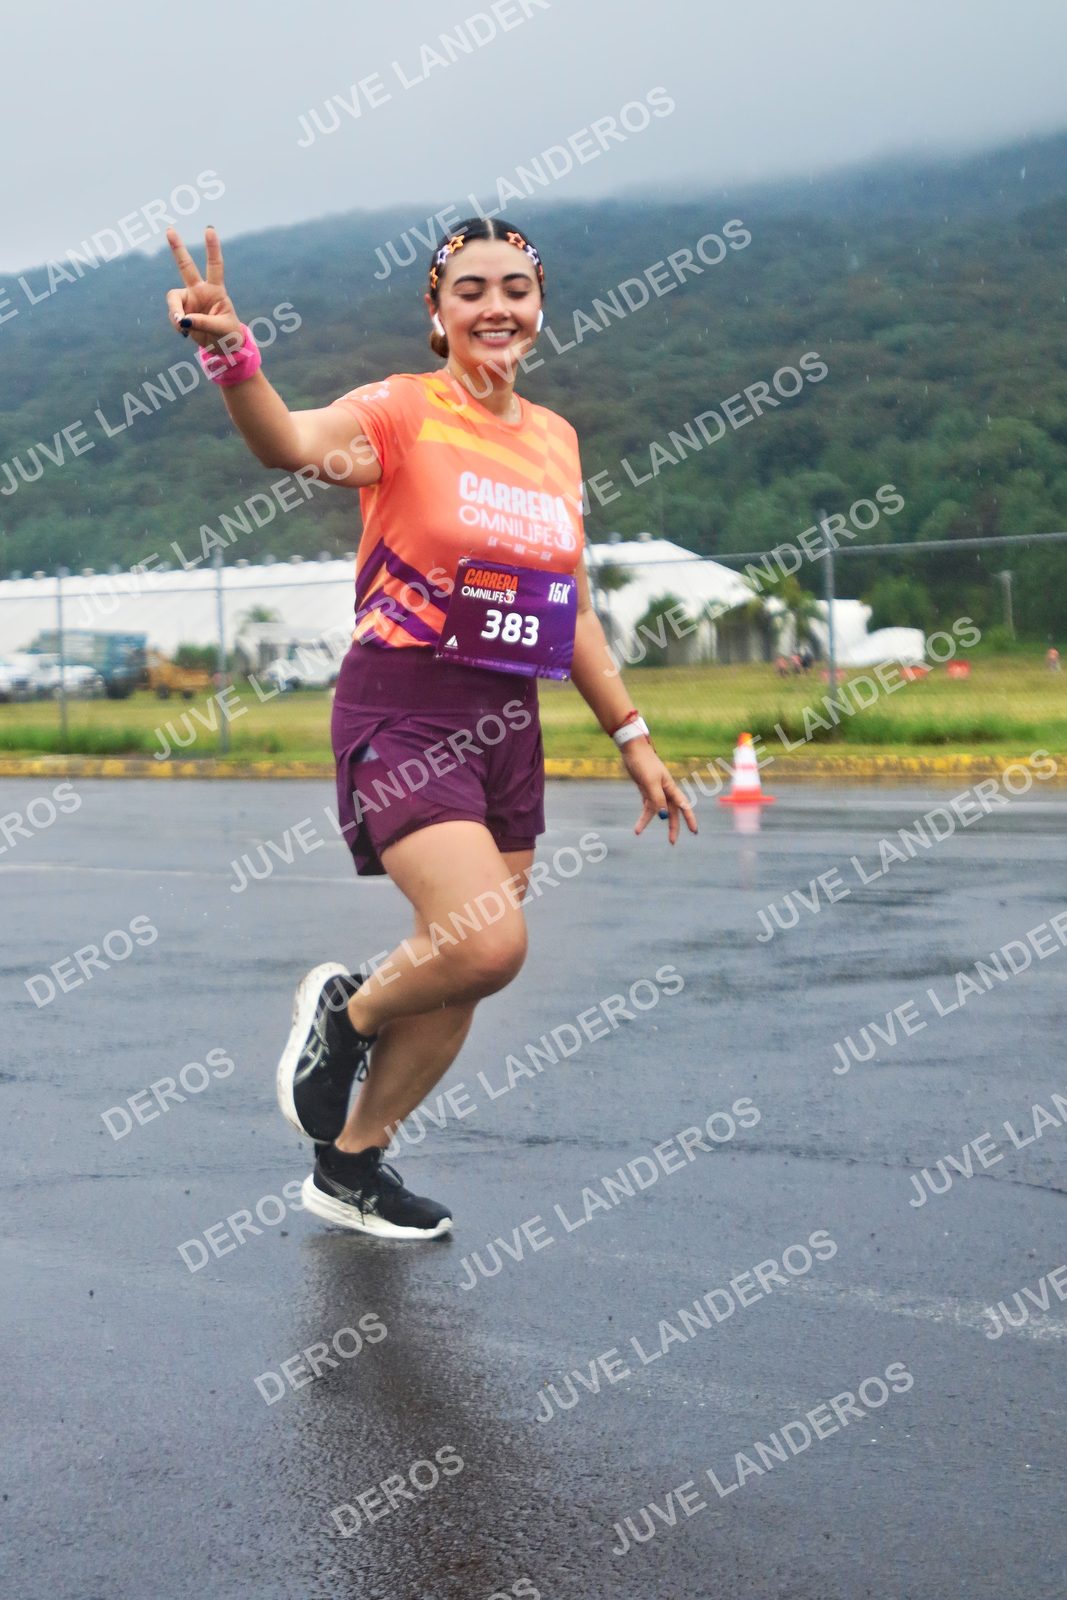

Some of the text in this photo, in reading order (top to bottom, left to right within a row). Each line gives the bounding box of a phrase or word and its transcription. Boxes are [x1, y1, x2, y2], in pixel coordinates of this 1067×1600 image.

[459, 471, 571, 525] CARRERA
[459, 505, 553, 546] OMNILIFE
[461, 585, 504, 603] OMNILIFE
[464, 568, 518, 591] CARRERA
[547, 582, 572, 604] 15K
[480, 609, 540, 646] 383
